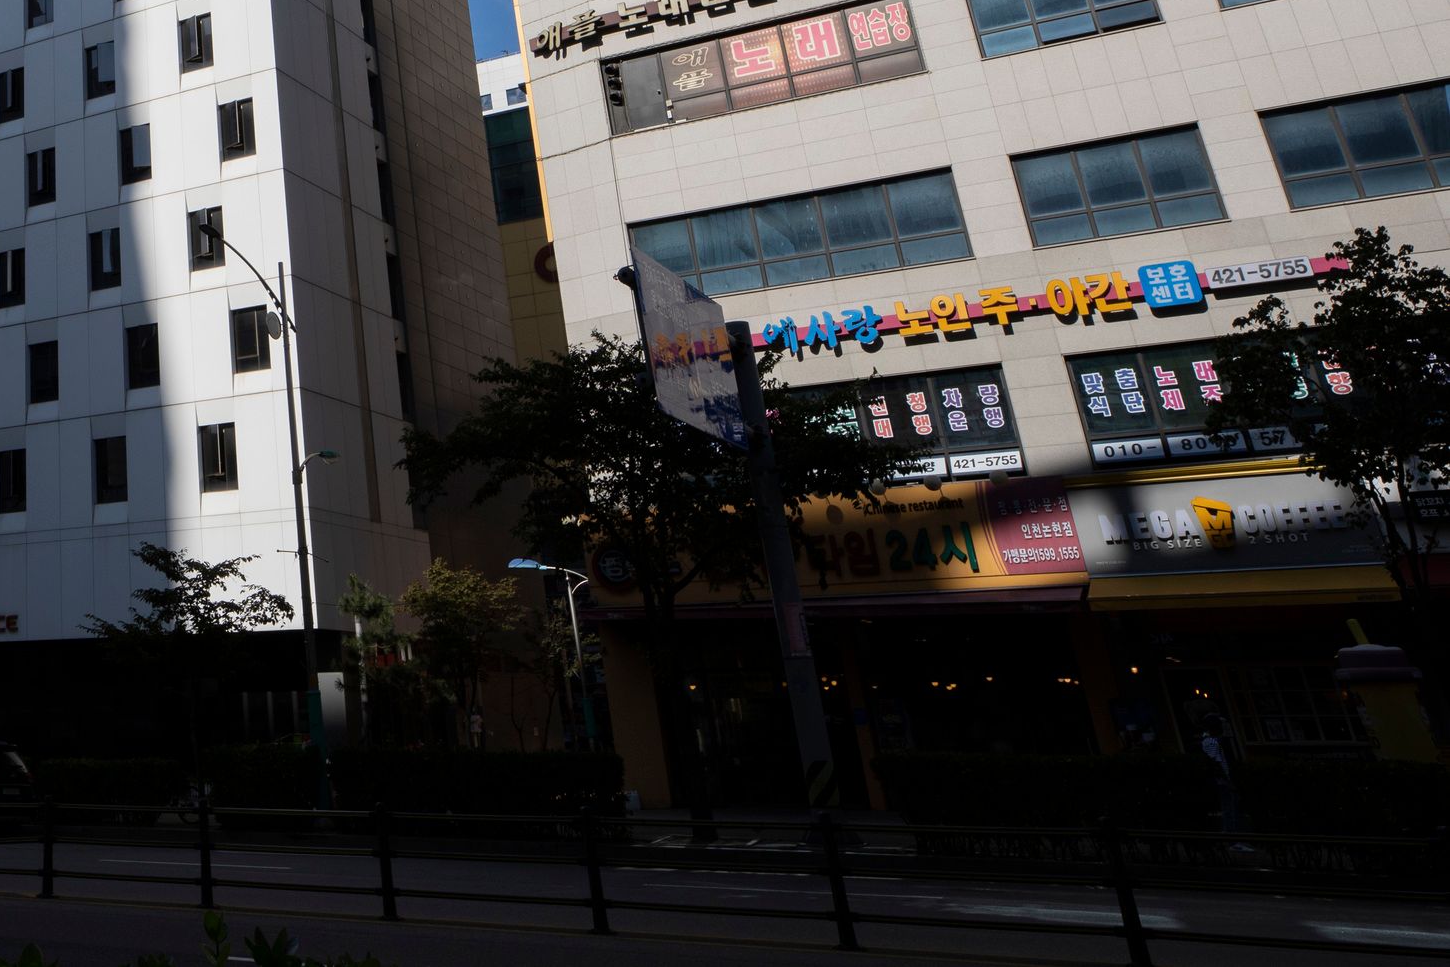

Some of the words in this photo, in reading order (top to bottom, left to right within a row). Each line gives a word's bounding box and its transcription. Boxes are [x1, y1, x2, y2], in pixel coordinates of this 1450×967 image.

[535, 8, 603, 53] 애플
[730, 16, 840, 78] 노래
[847, 1, 912, 54] 연습장
[1146, 264, 1191, 285] 보호
[1211, 258, 1308, 286] 421-5755
[1150, 282, 1195, 305] 센터
[1080, 367, 1138, 395] 맞춤
[1153, 359, 1219, 387] 노래
[941, 384, 1000, 409] 차량
[1087, 391, 1145, 418] 식단
[873, 413, 933, 439] 대행
[947, 407, 1004, 433] 운행
[953, 454, 1018, 469] 421-5755
[863, 501, 906, 516] Chinese
[908, 497, 964, 512] restaurant
[1021, 521, 1074, 539] 인천논현점
[1098, 508, 1201, 544] MEGA
[1237, 498, 1348, 534] COFFEE
[1133, 538, 1160, 552] BIG
[1166, 537, 1203, 550] SIZE
[1264, 532, 1310, 544] SHOT
